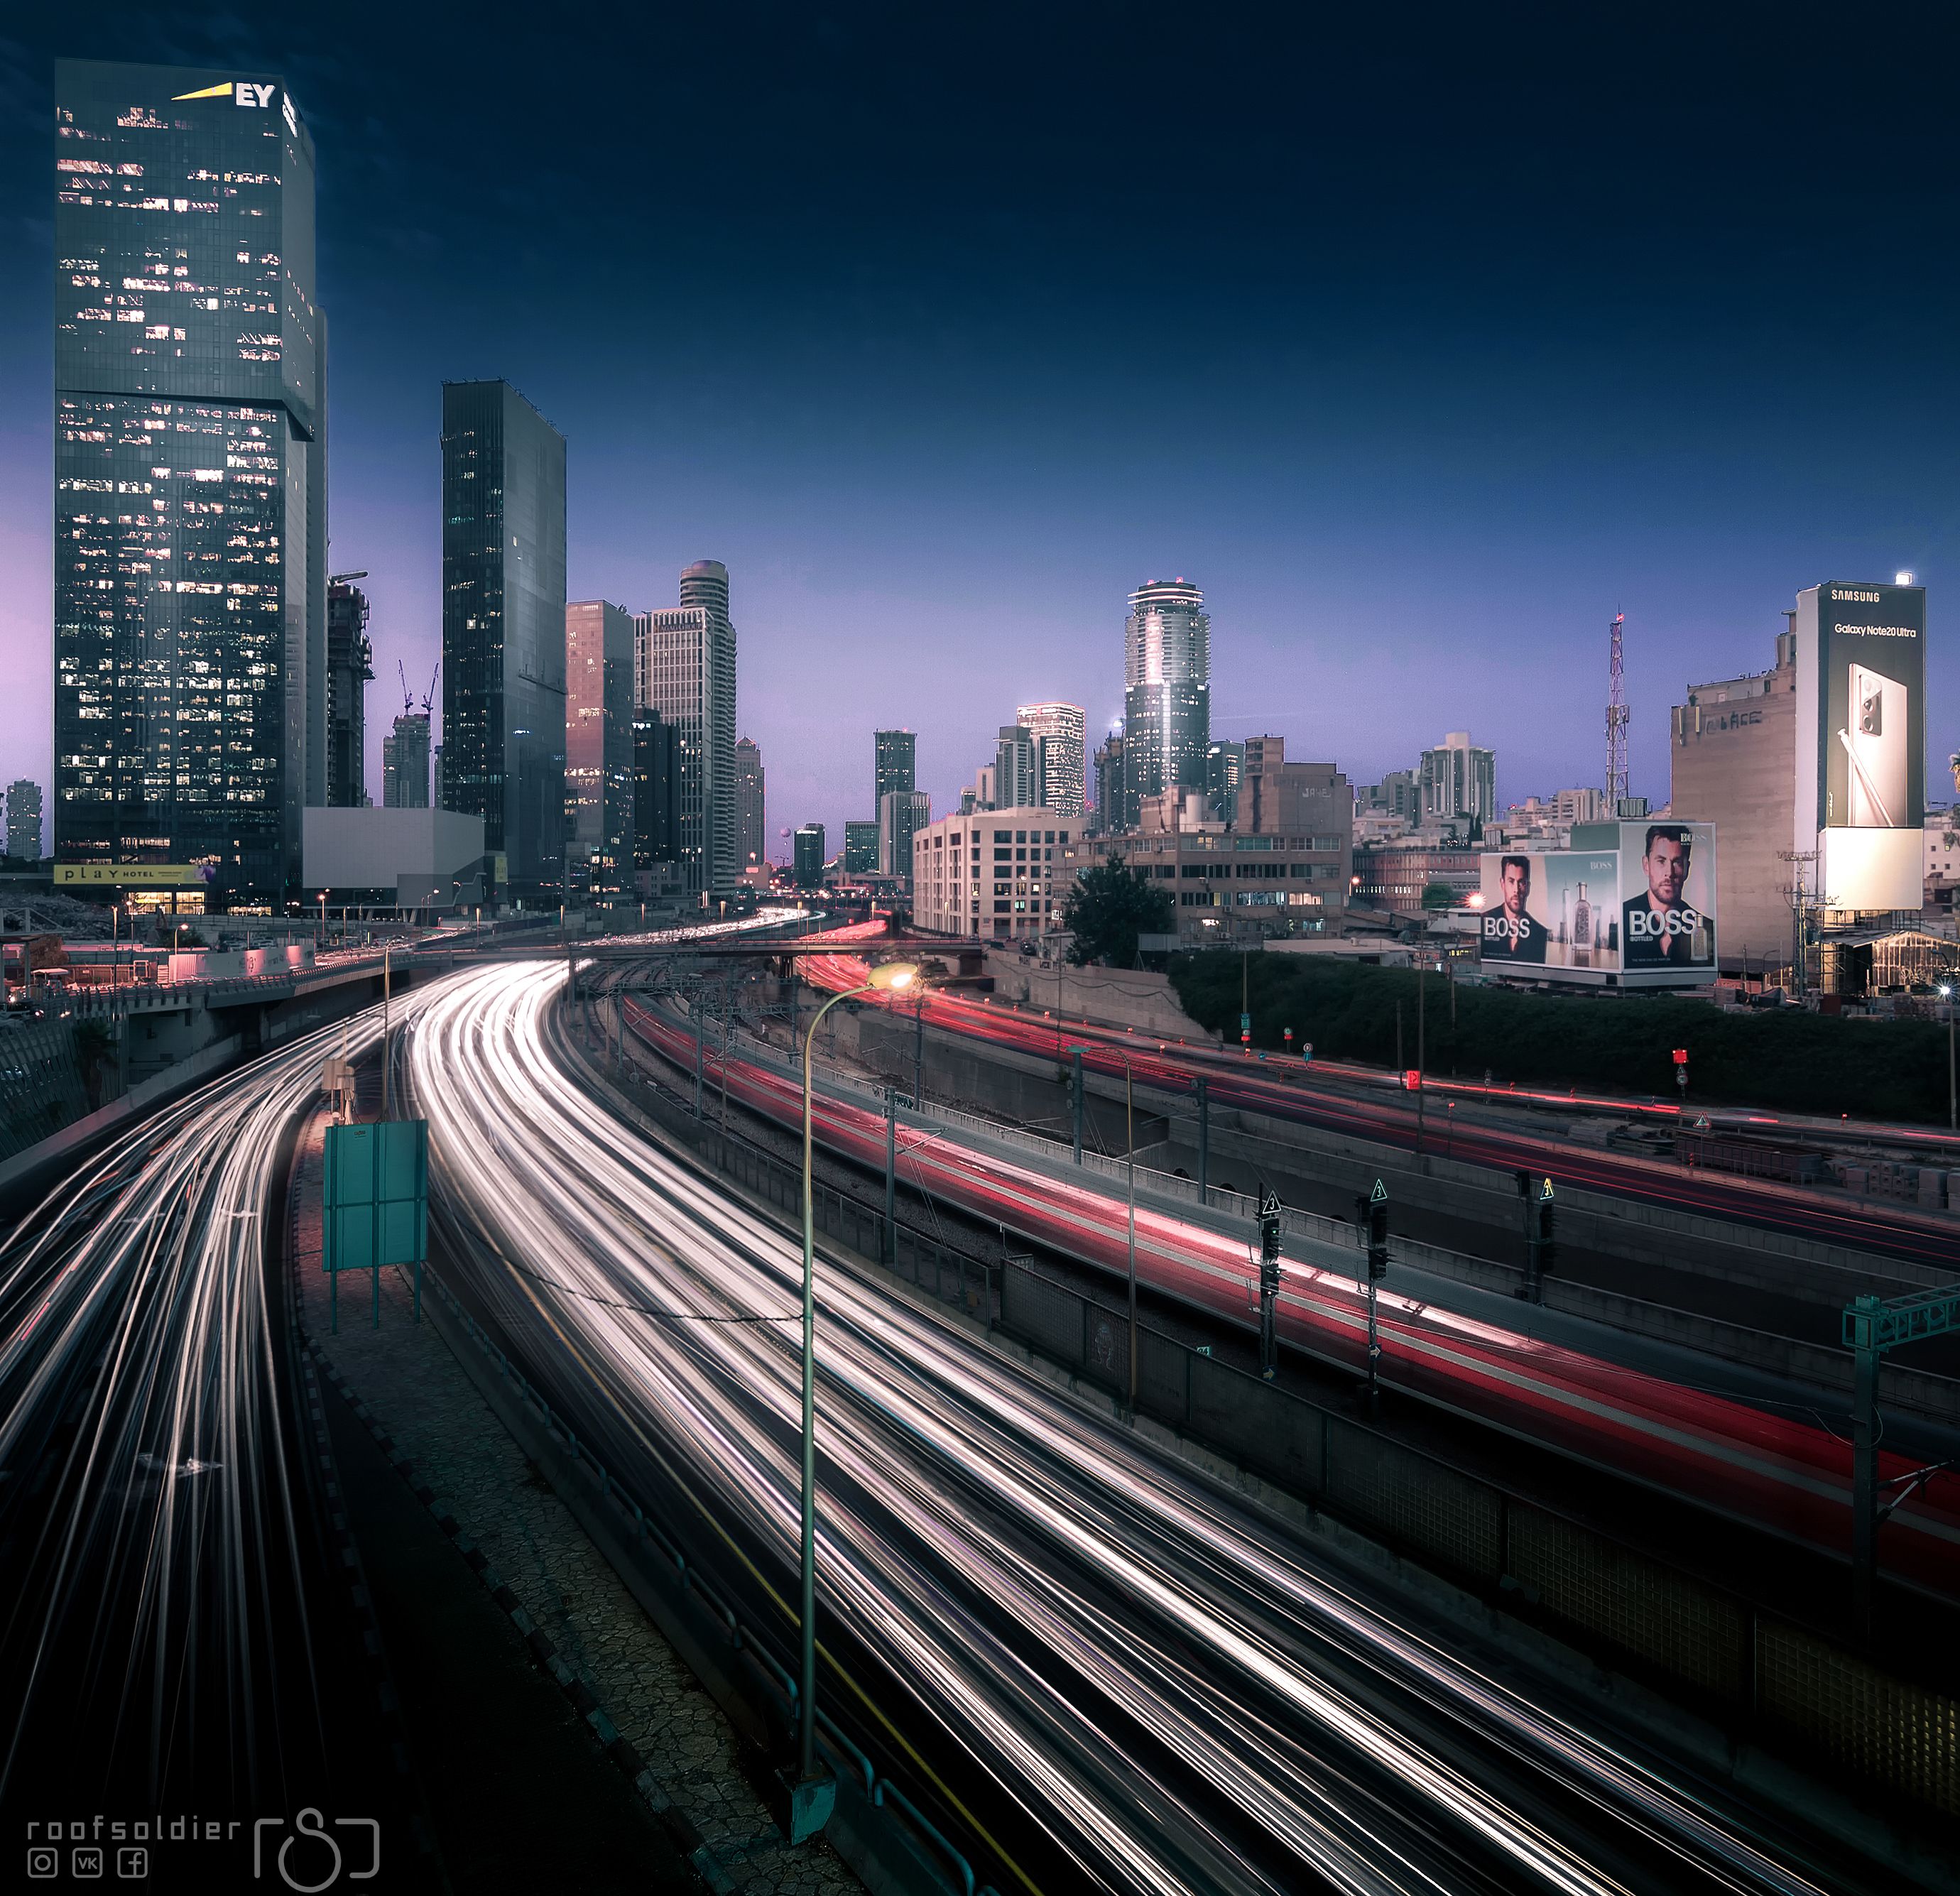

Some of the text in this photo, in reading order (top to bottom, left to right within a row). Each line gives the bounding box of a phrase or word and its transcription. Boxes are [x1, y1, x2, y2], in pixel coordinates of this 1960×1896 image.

[236, 83, 276, 107] EY
[1831, 589, 1880, 602] SAMSUNG
[1834, 623, 1917, 638] Galaxy Note20 Ultra
[1591, 861, 1612, 870] BOSS
[1485, 917, 1530, 938] BOSS
[1629, 909, 1697, 935] BOSS
[1377, 1186, 1381, 1197] 3
[1545, 1185, 1549, 1197] 3
[1270, 1197, 1275, 1209] 3
